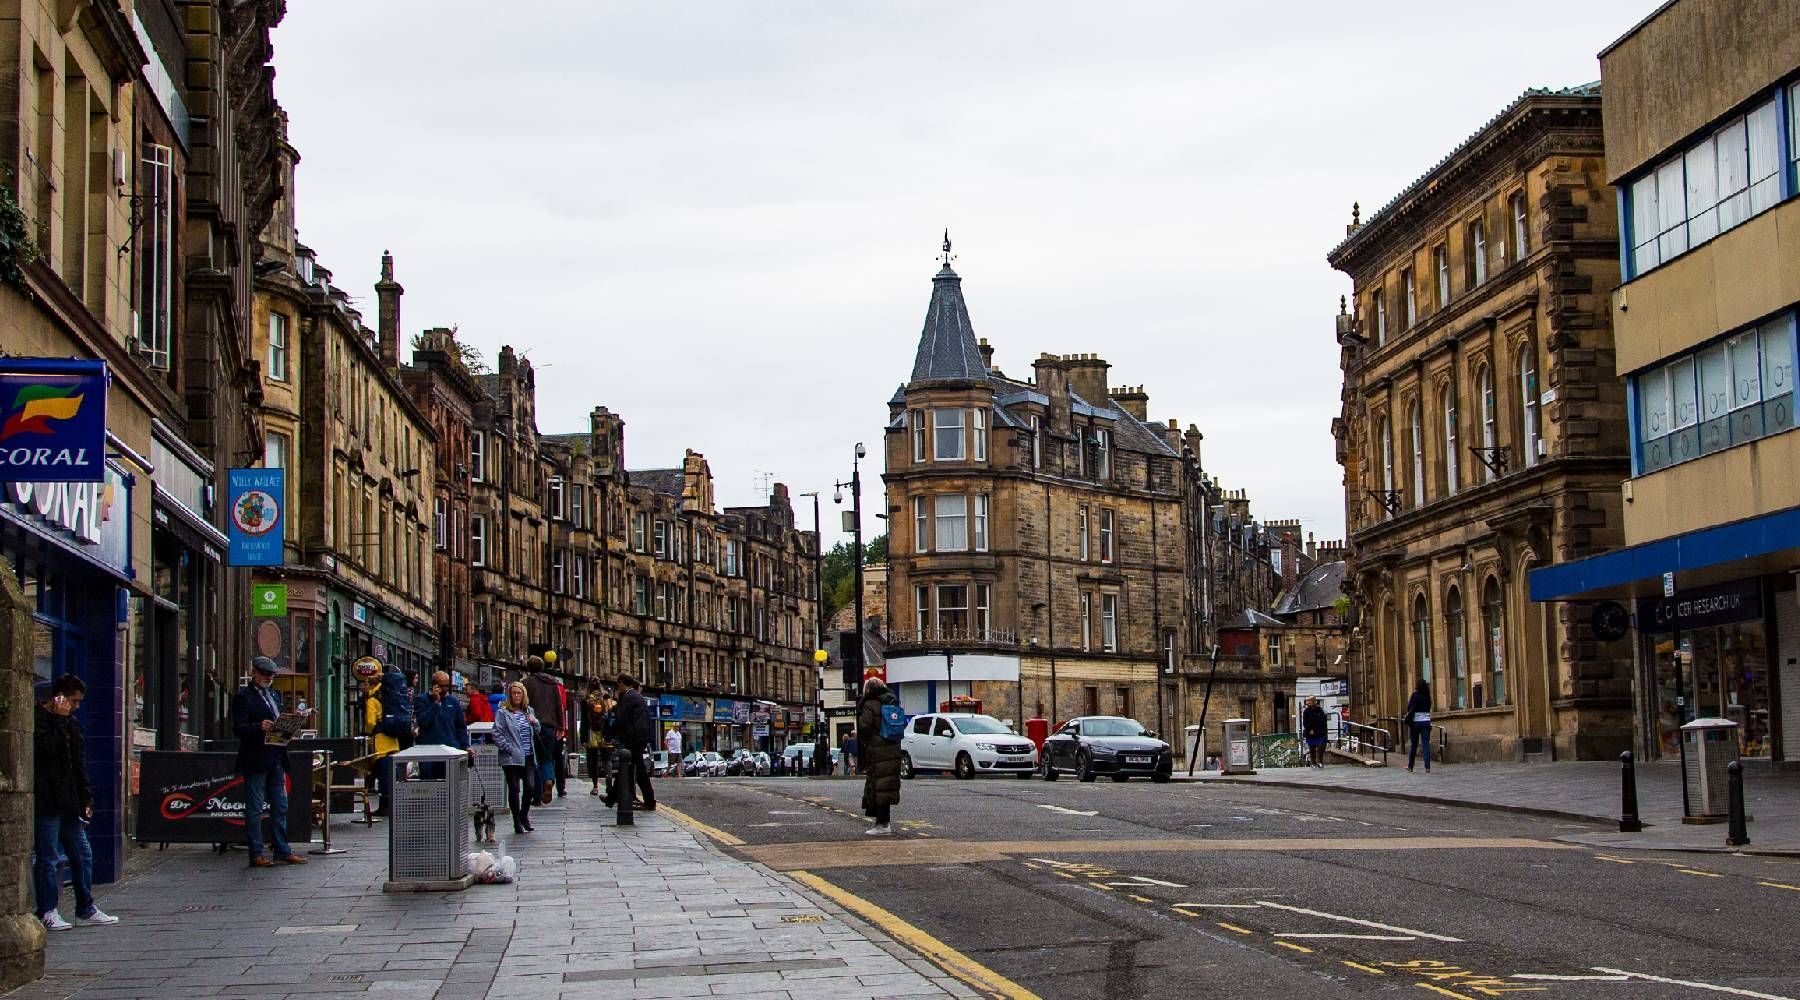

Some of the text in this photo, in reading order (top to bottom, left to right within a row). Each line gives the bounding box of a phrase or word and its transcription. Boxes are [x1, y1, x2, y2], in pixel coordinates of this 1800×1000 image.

[1693, 596, 1729, 615] RESEARCH
[1730, 593, 1741, 610] UK
[170, 799, 192, 810] Dr
